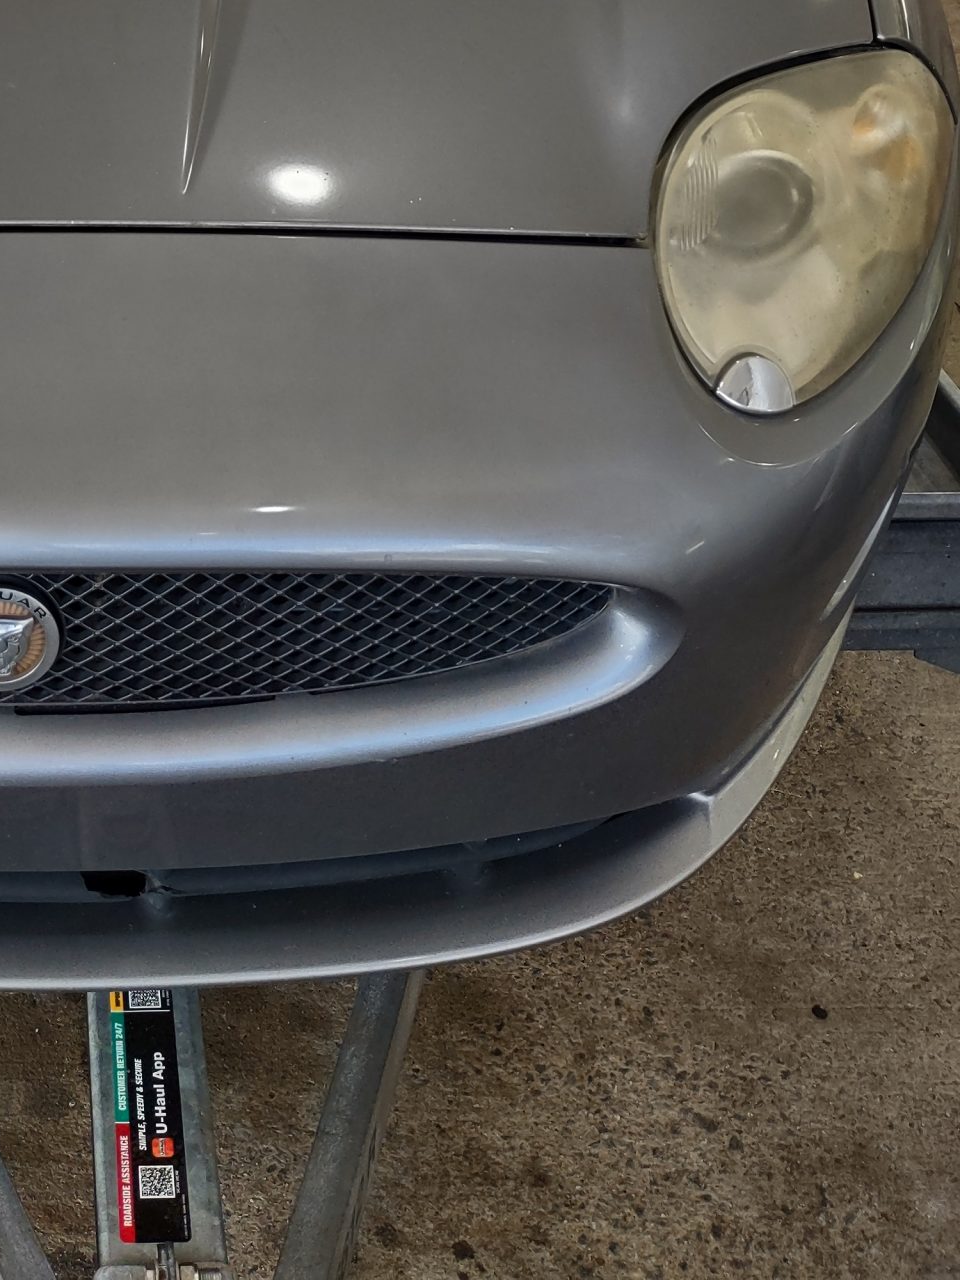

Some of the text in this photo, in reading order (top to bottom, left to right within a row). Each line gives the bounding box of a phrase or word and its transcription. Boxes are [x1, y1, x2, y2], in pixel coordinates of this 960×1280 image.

[114, 1022, 127, 1111] CUSTOMER RETURN 24/7
[134, 1058, 143, 1085] SECURE
[152, 1051, 168, 1134] U-Haul App
[136, 1093, 145, 1120] SPEEDY
[138, 1121, 148, 1151] SIMPLE,
[120, 1135, 133, 1227] ROADSIDE ASSISTANCE
